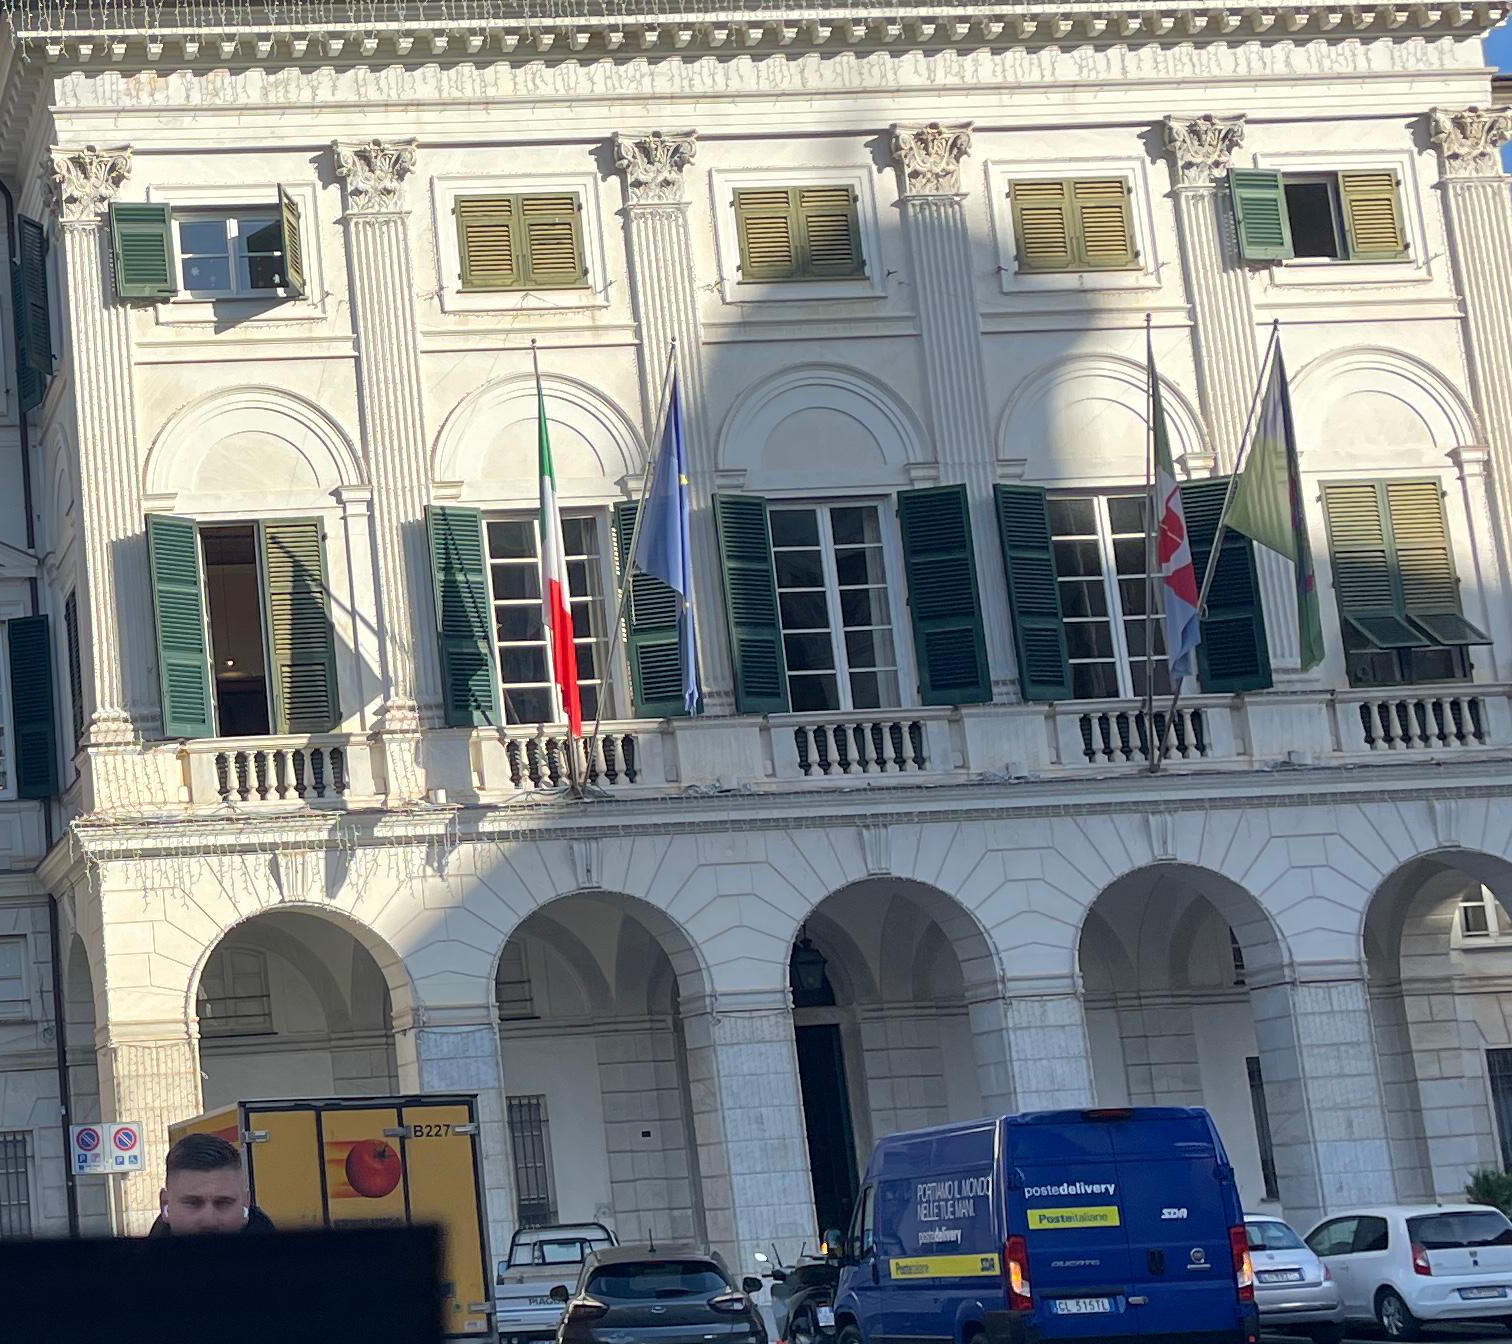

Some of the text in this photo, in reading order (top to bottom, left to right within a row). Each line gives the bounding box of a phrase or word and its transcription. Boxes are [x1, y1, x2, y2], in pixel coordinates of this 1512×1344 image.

[413, 1124, 451, 1138] B227
[917, 1180, 953, 1202] PORTIAMO
[961, 1176, 992, 1198] MONDO
[1024, 1182, 1116, 1199] postedelivery
[917, 1202, 940, 1221] NELLE
[940, 1201, 954, 1219] TUE
[1161, 1208, 1188, 1219] SDA
[918, 1226, 962, 1246] postedelivery
